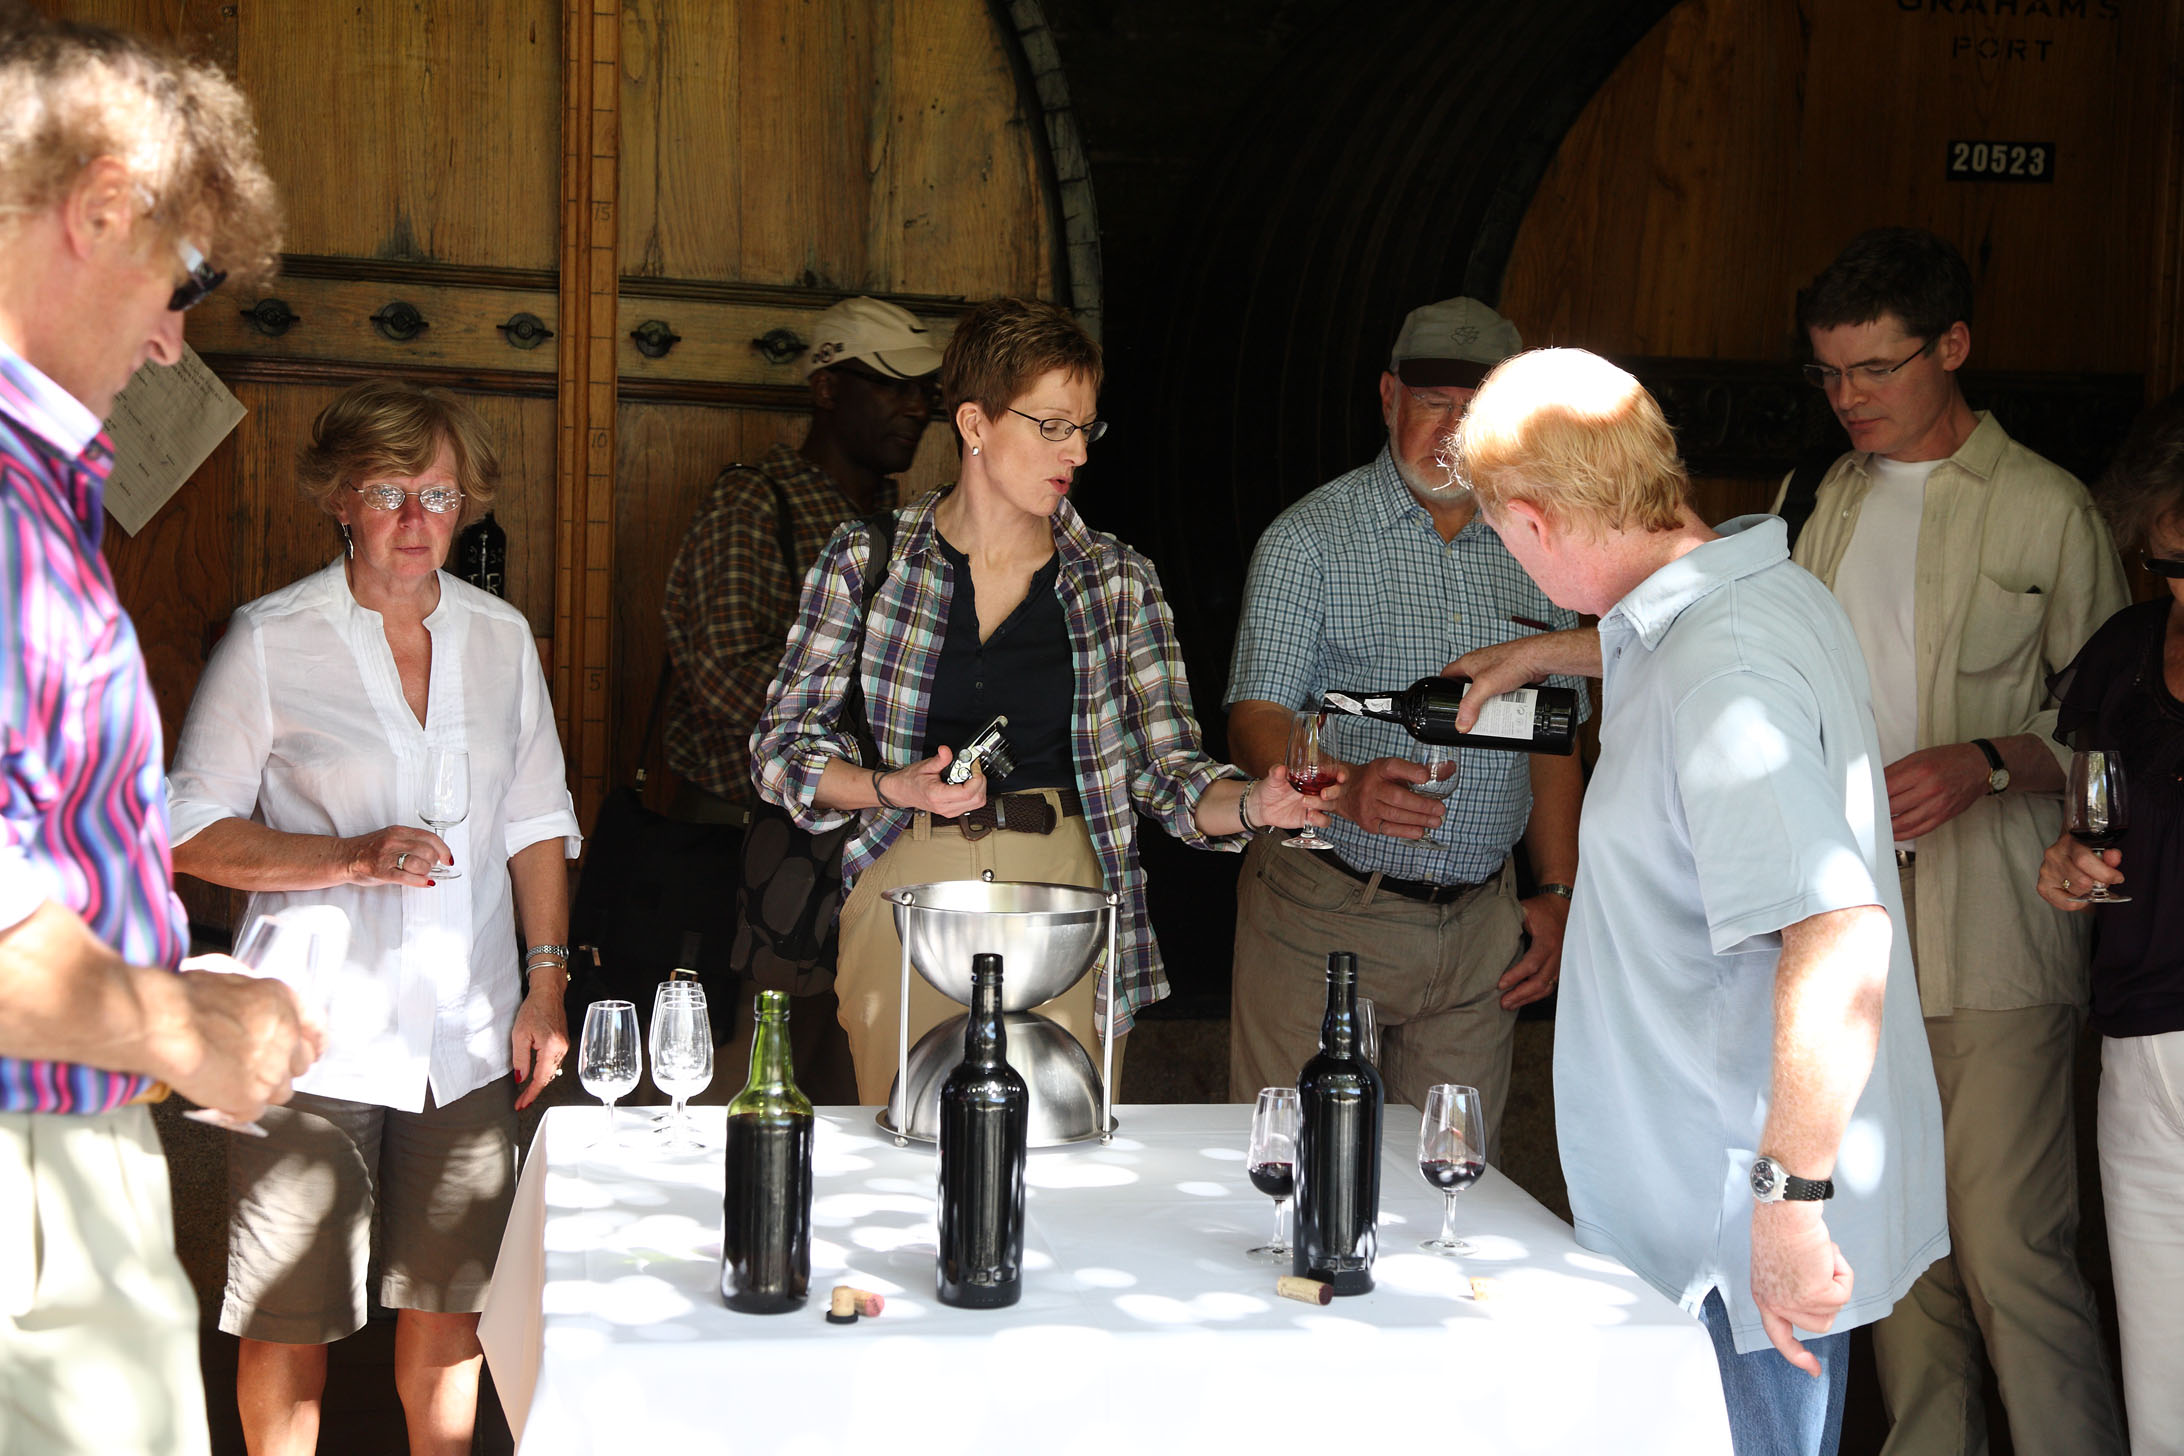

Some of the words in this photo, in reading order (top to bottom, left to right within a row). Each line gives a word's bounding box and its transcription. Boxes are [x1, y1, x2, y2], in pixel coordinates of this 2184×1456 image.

[1953, 37, 2053, 61] PORT
[1951, 142, 2046, 176] 20523
[594, 206, 610, 221] 15
[591, 432, 608, 448] 10
[590, 673, 600, 691] 5
